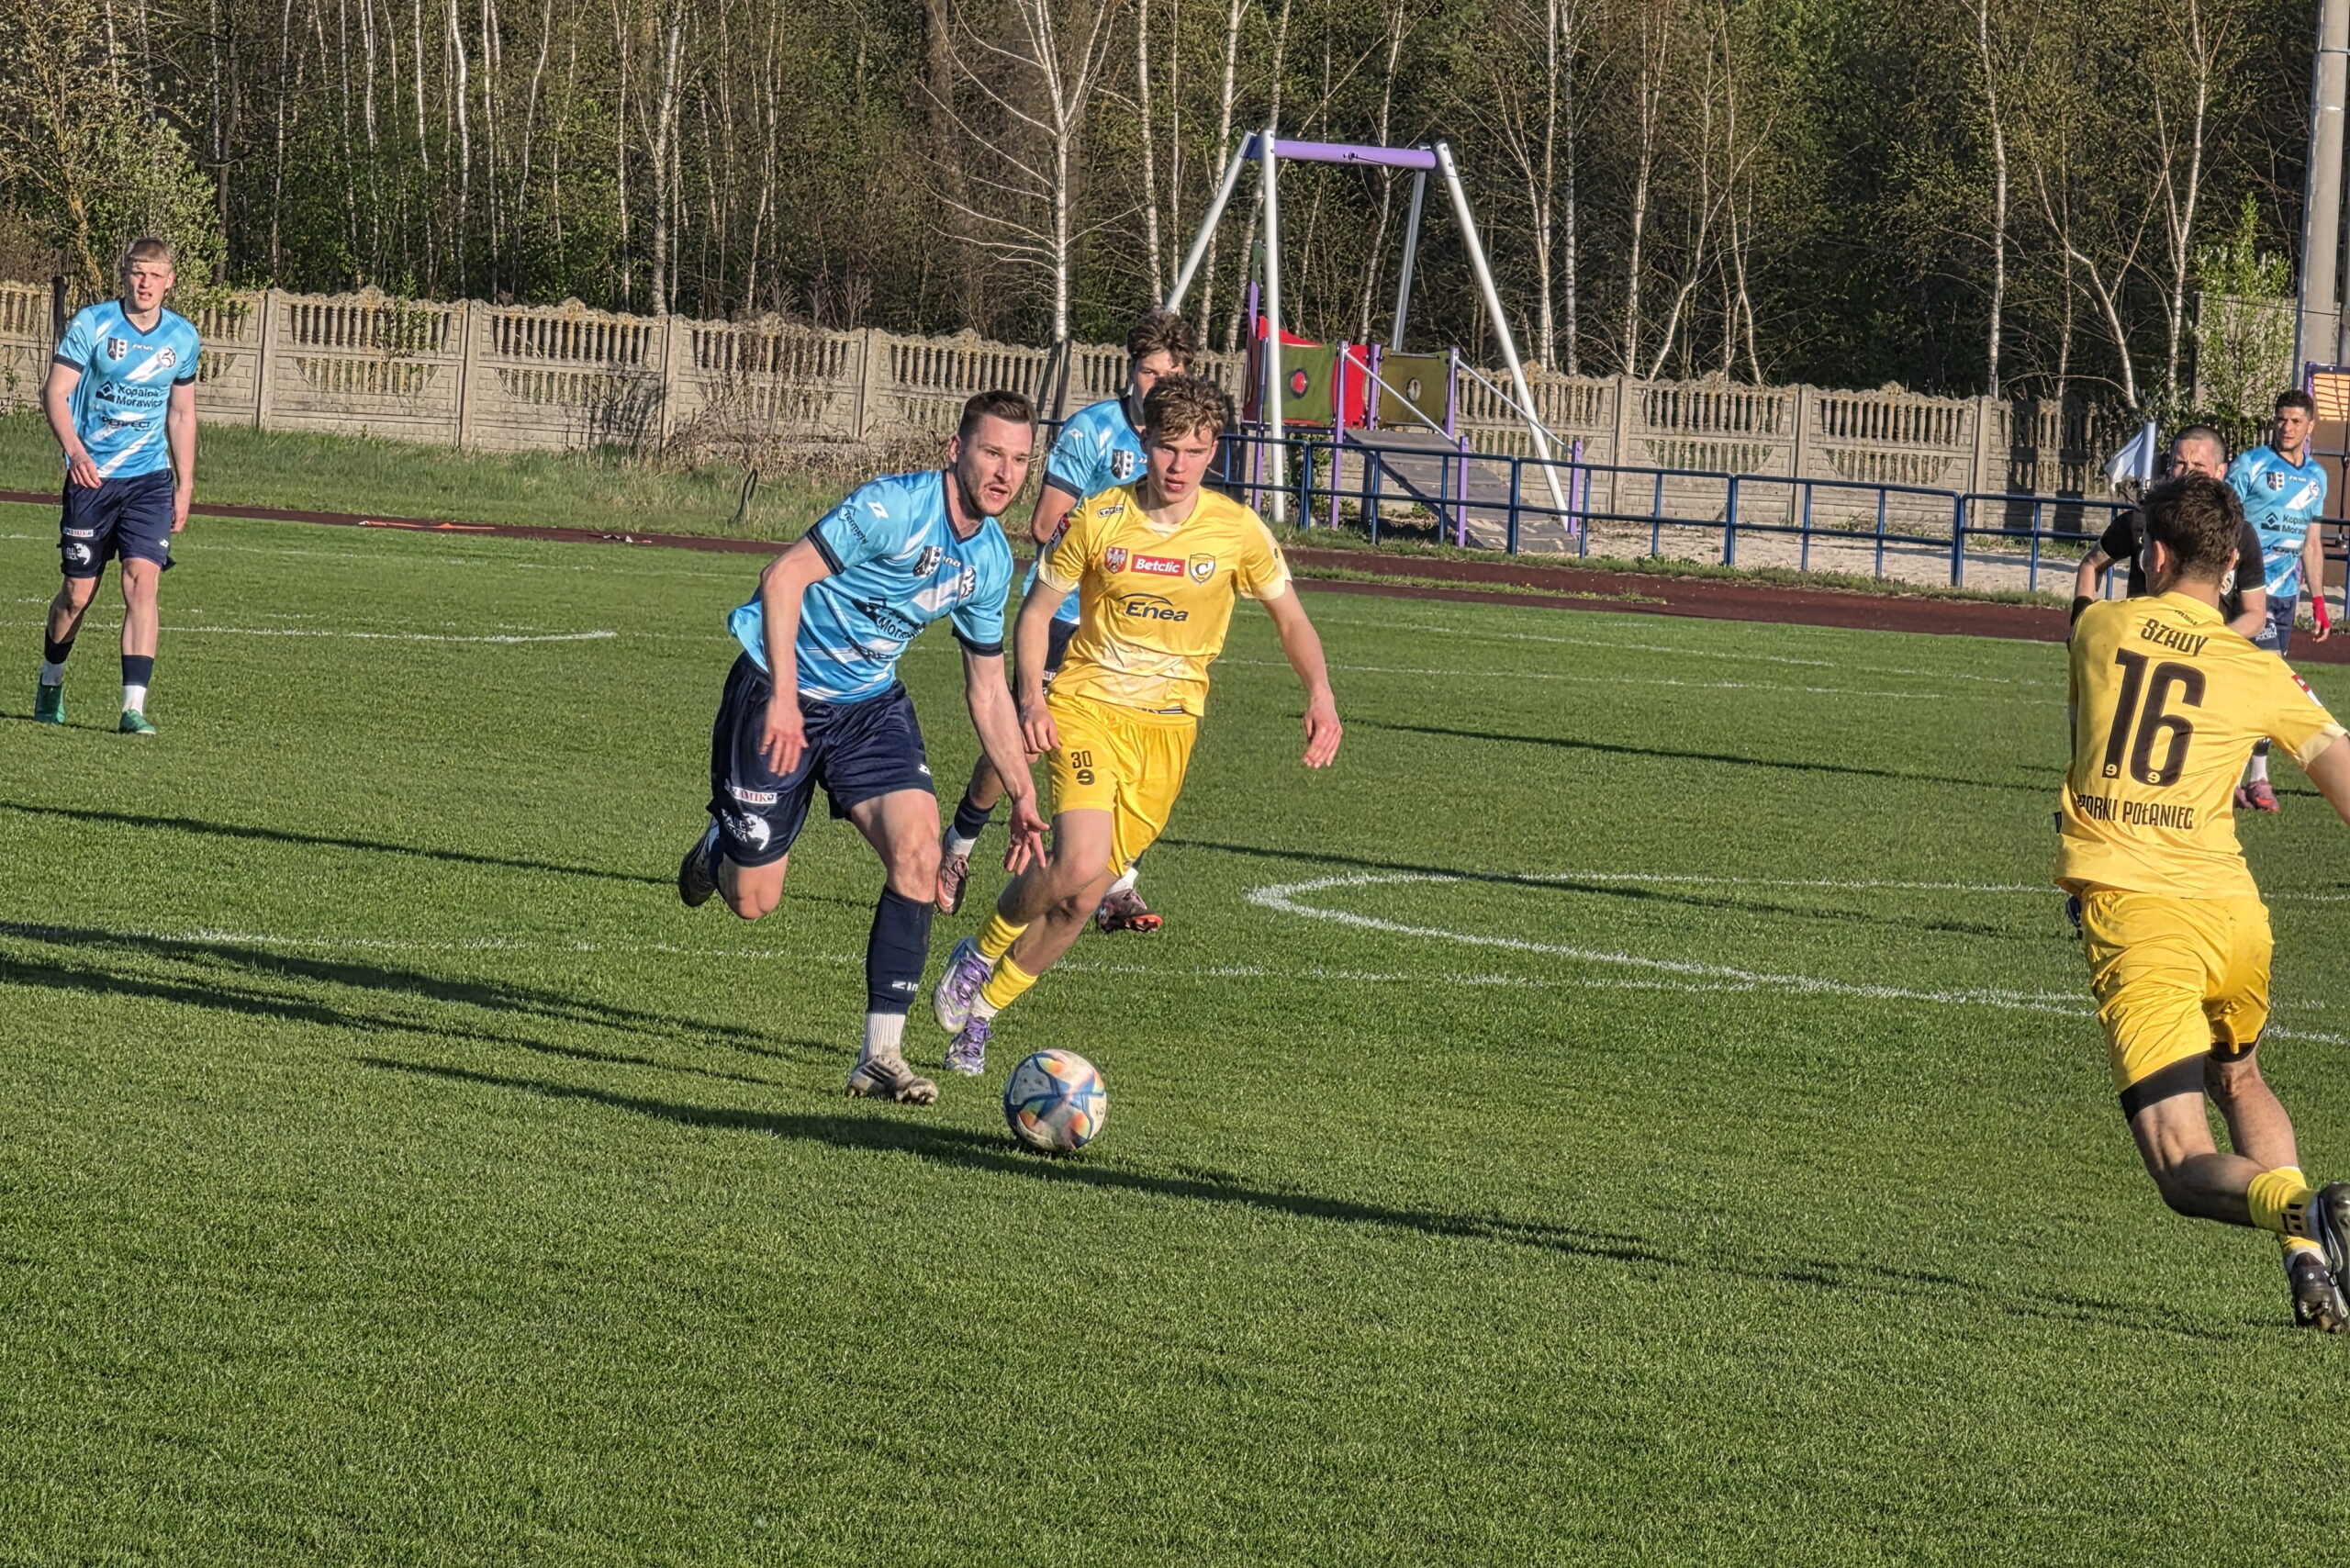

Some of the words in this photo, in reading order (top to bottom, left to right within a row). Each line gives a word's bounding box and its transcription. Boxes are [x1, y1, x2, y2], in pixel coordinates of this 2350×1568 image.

[1135, 557, 1181, 573] Betclic
[1125, 601, 1189, 622] Enea
[2102, 647, 2206, 787] 16
[1070, 750, 1093, 768] 30
[2077, 794, 2118, 821] ARNI
